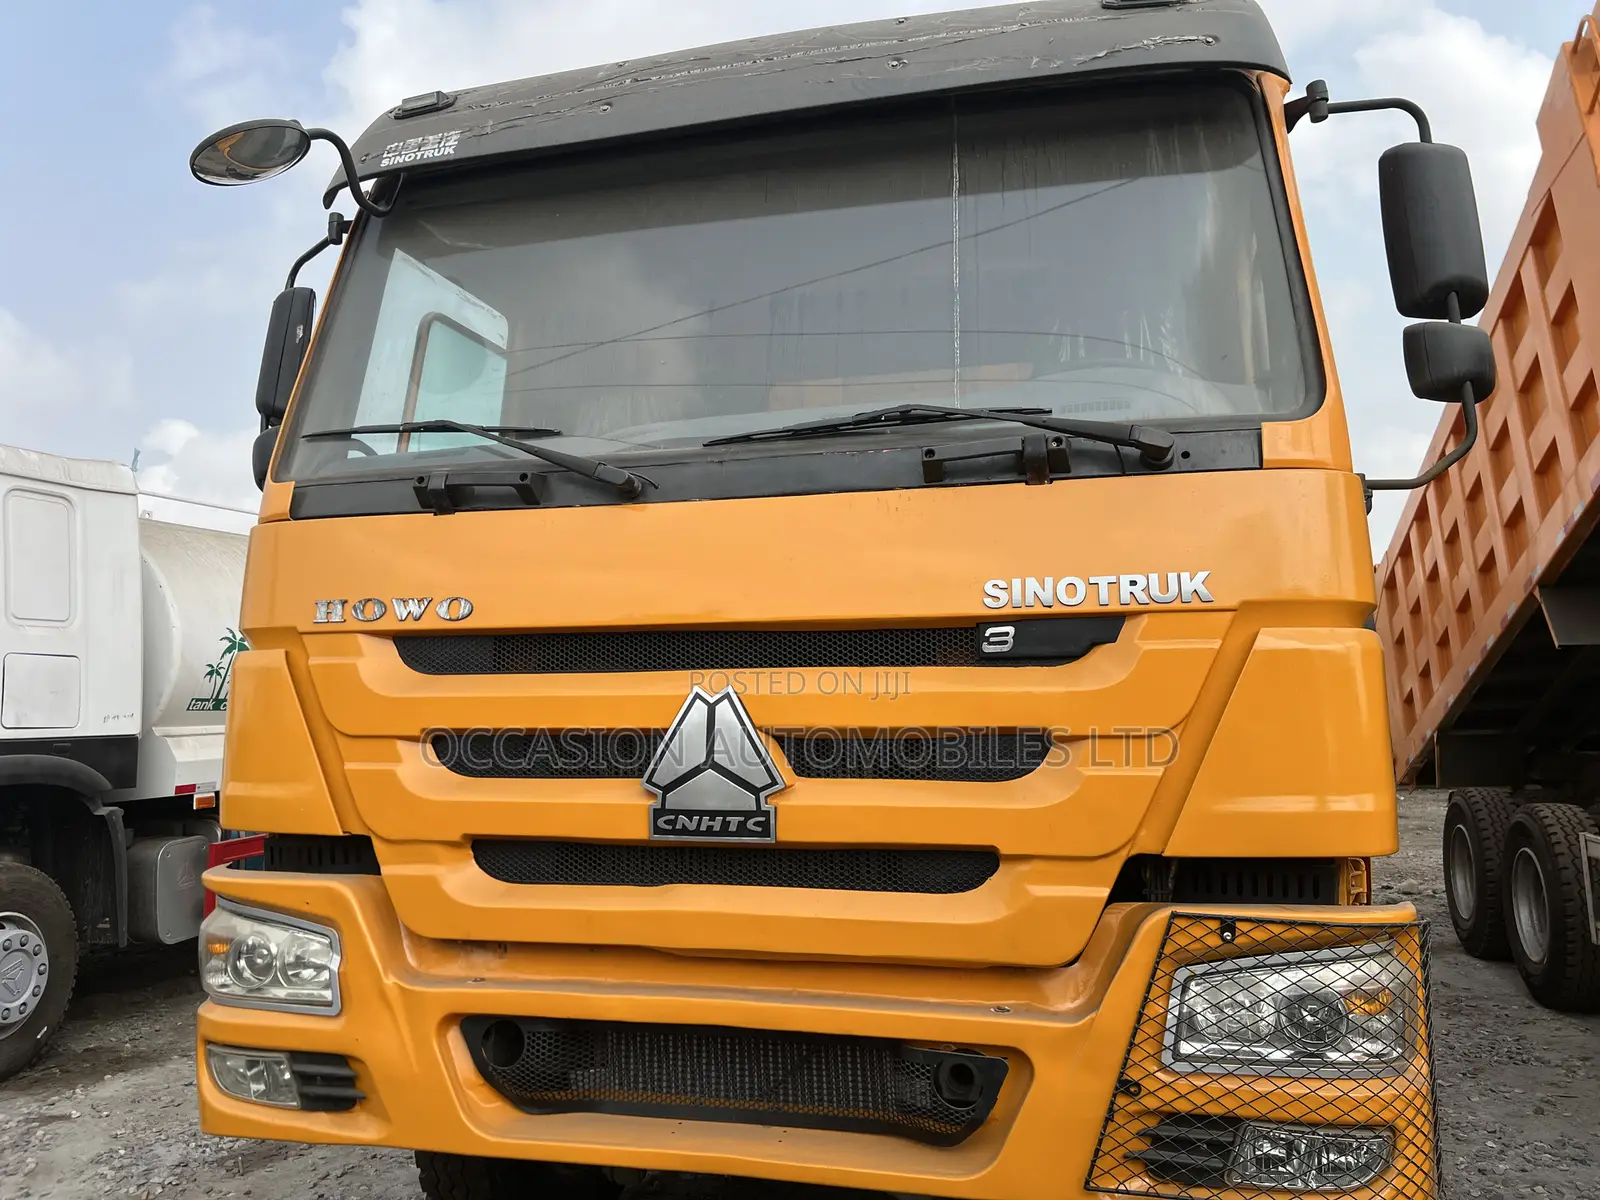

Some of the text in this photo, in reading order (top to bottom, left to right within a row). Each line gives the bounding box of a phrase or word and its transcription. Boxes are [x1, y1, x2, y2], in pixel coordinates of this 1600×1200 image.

[380, 145, 456, 167] SINOTRUK
[983, 571, 1214, 608] SINOTRUK
[313, 597, 473, 623] HOWO
[981, 625, 1015, 653] 3
[189, 699, 215, 710] tank
[656, 814, 767, 833] CNHTC
